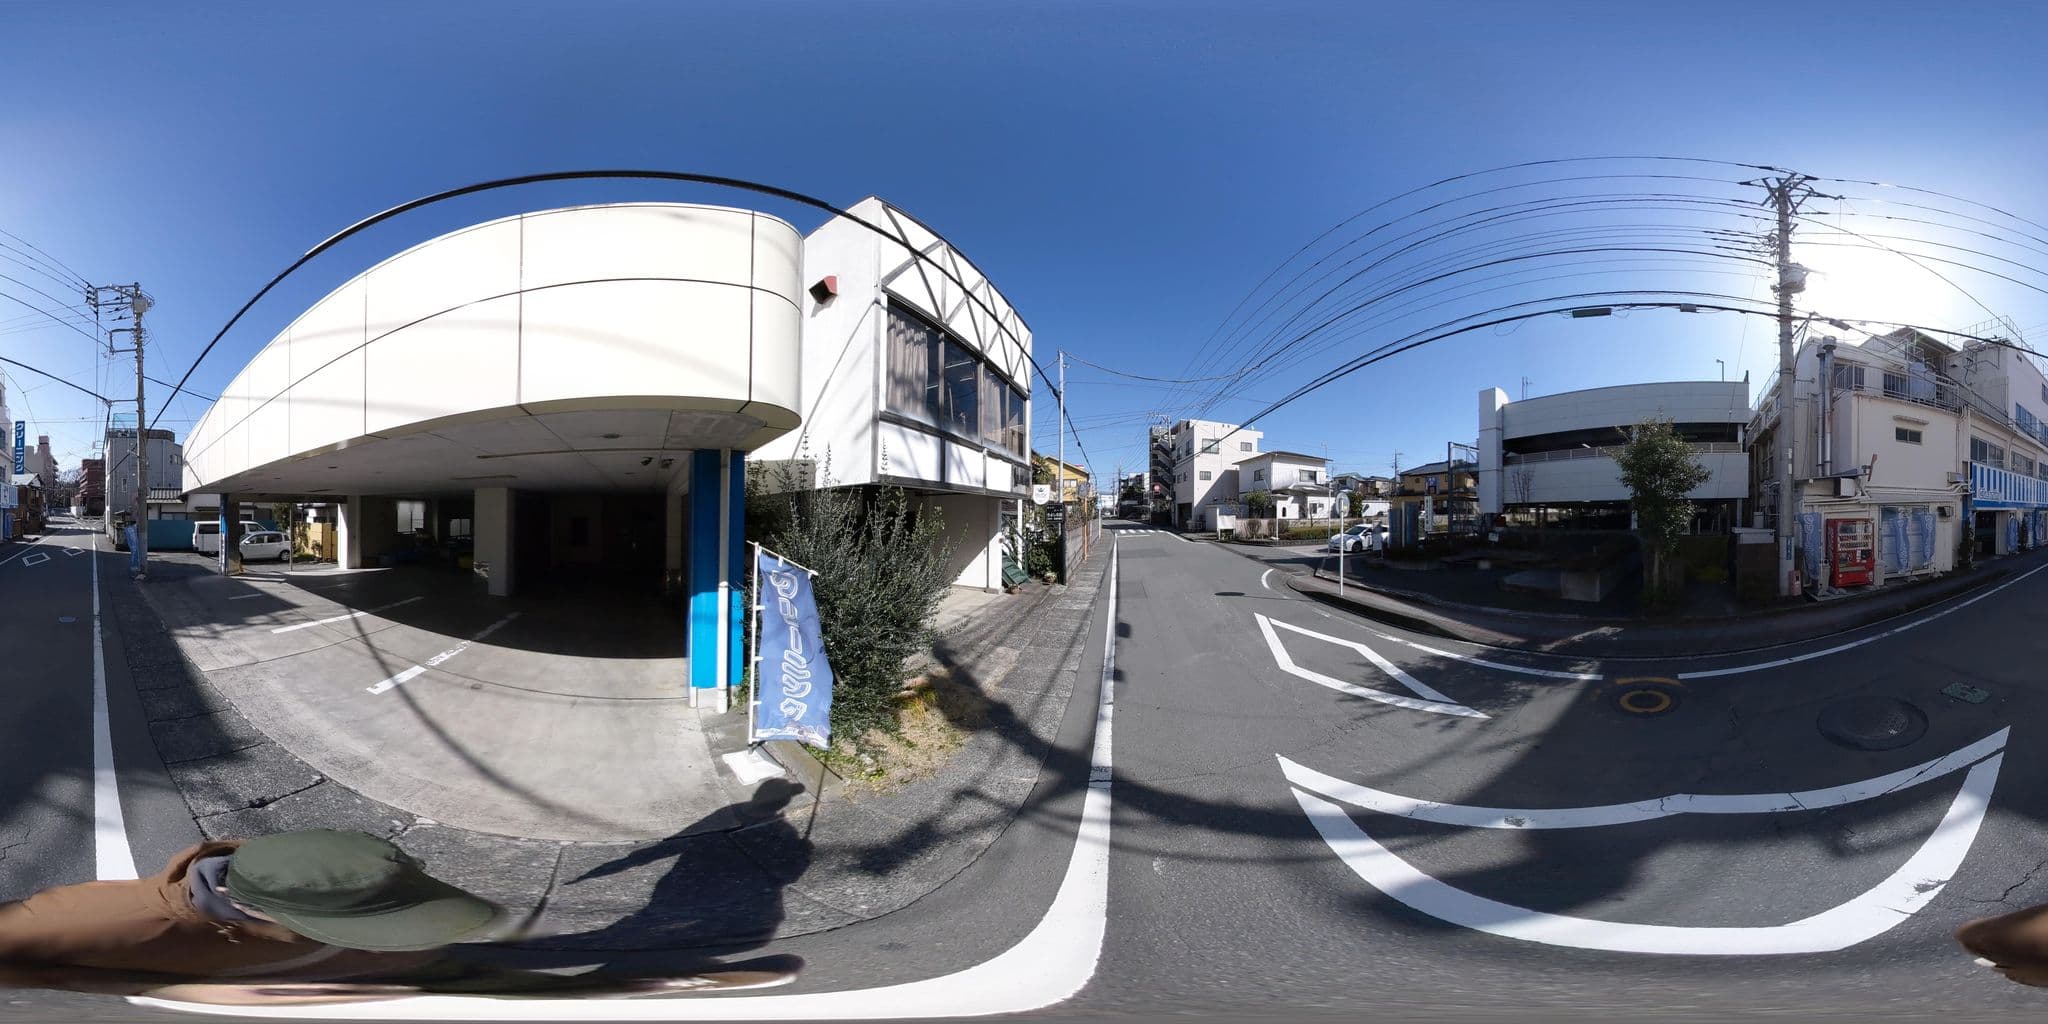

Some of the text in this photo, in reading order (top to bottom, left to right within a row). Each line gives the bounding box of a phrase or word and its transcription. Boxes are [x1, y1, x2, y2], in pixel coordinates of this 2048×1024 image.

[16, 423, 24, 472] クリーニング
[770, 570, 812, 722] クリーニング
